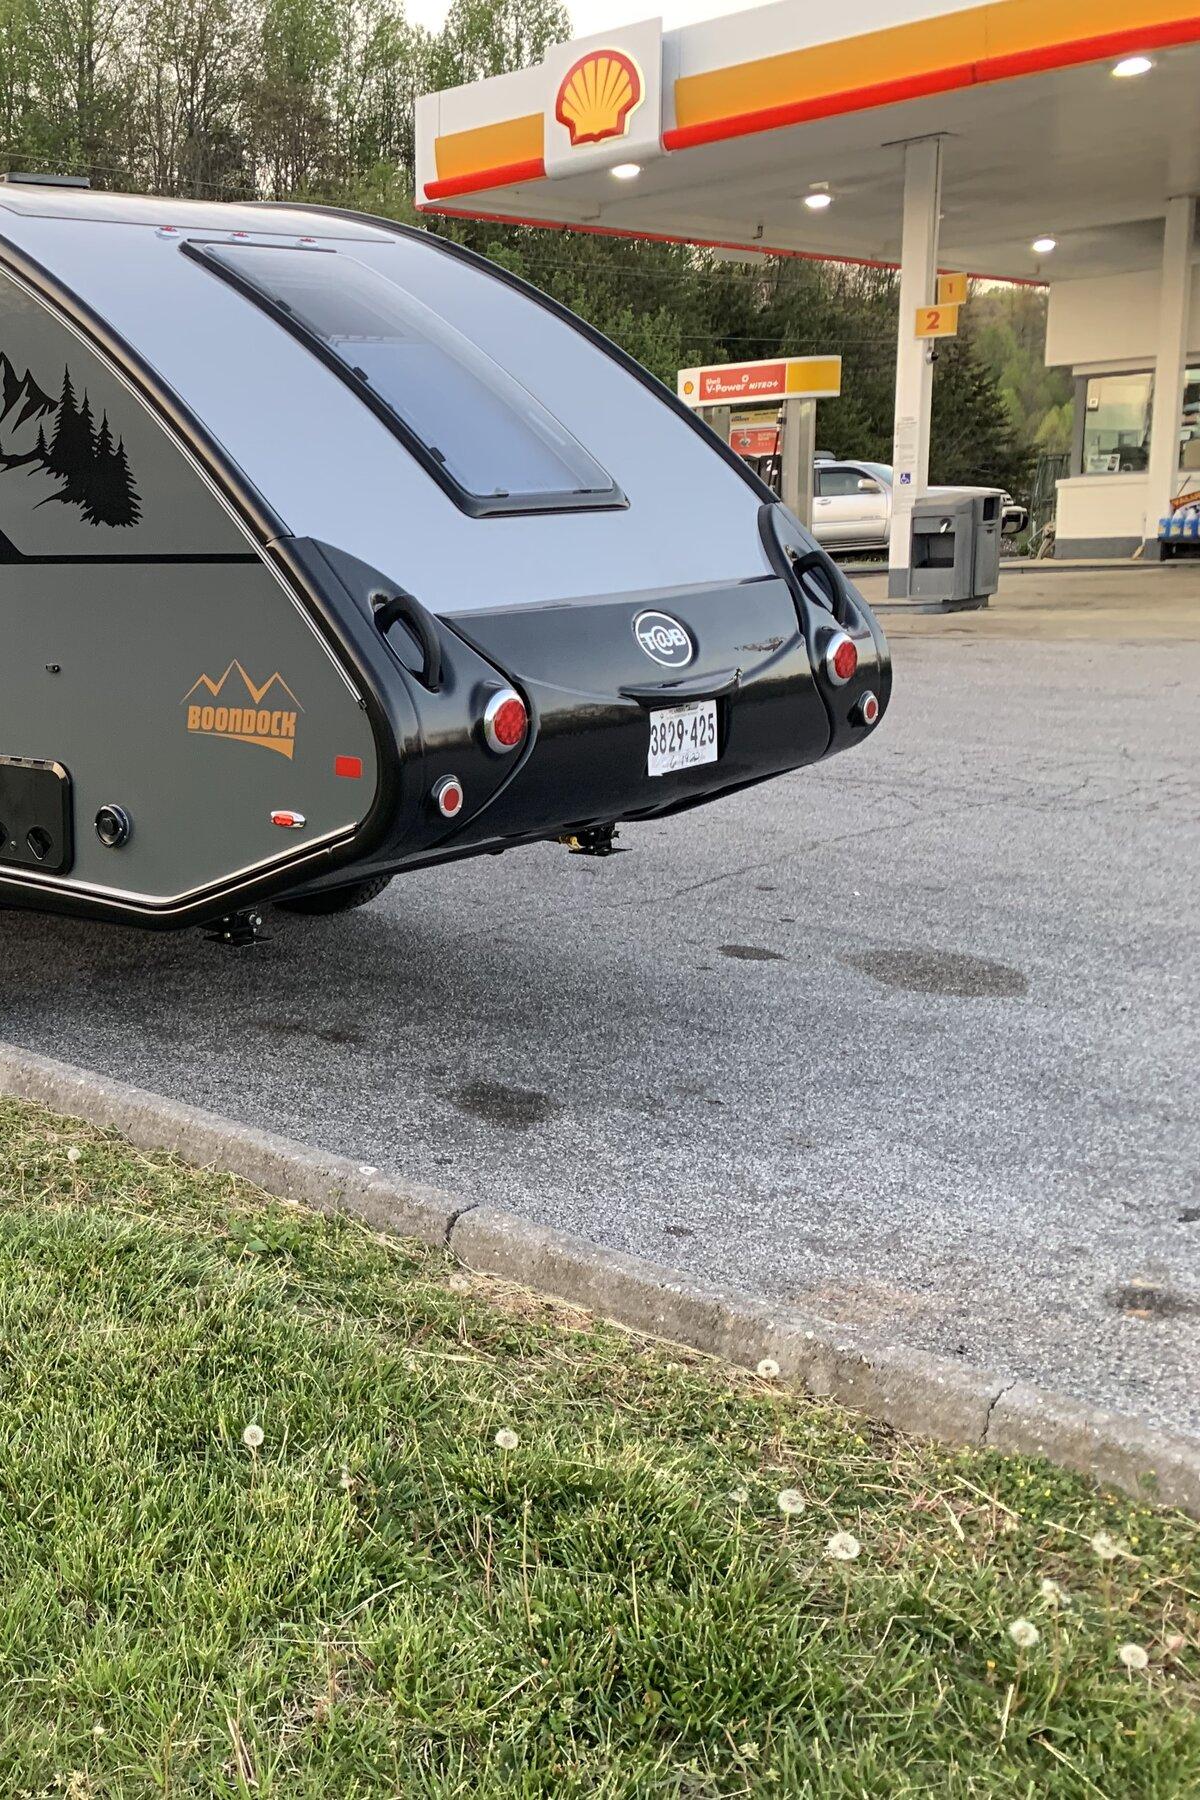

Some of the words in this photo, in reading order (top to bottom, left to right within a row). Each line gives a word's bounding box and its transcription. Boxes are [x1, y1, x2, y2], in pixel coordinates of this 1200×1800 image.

[947, 283, 954, 294] 1
[926, 311, 940, 330] 2
[705, 377, 721, 386] Shell
[706, 383, 745, 394] V-Power
[639, 625, 687, 655] T@B
[187, 705, 297, 737] BOONDOCK
